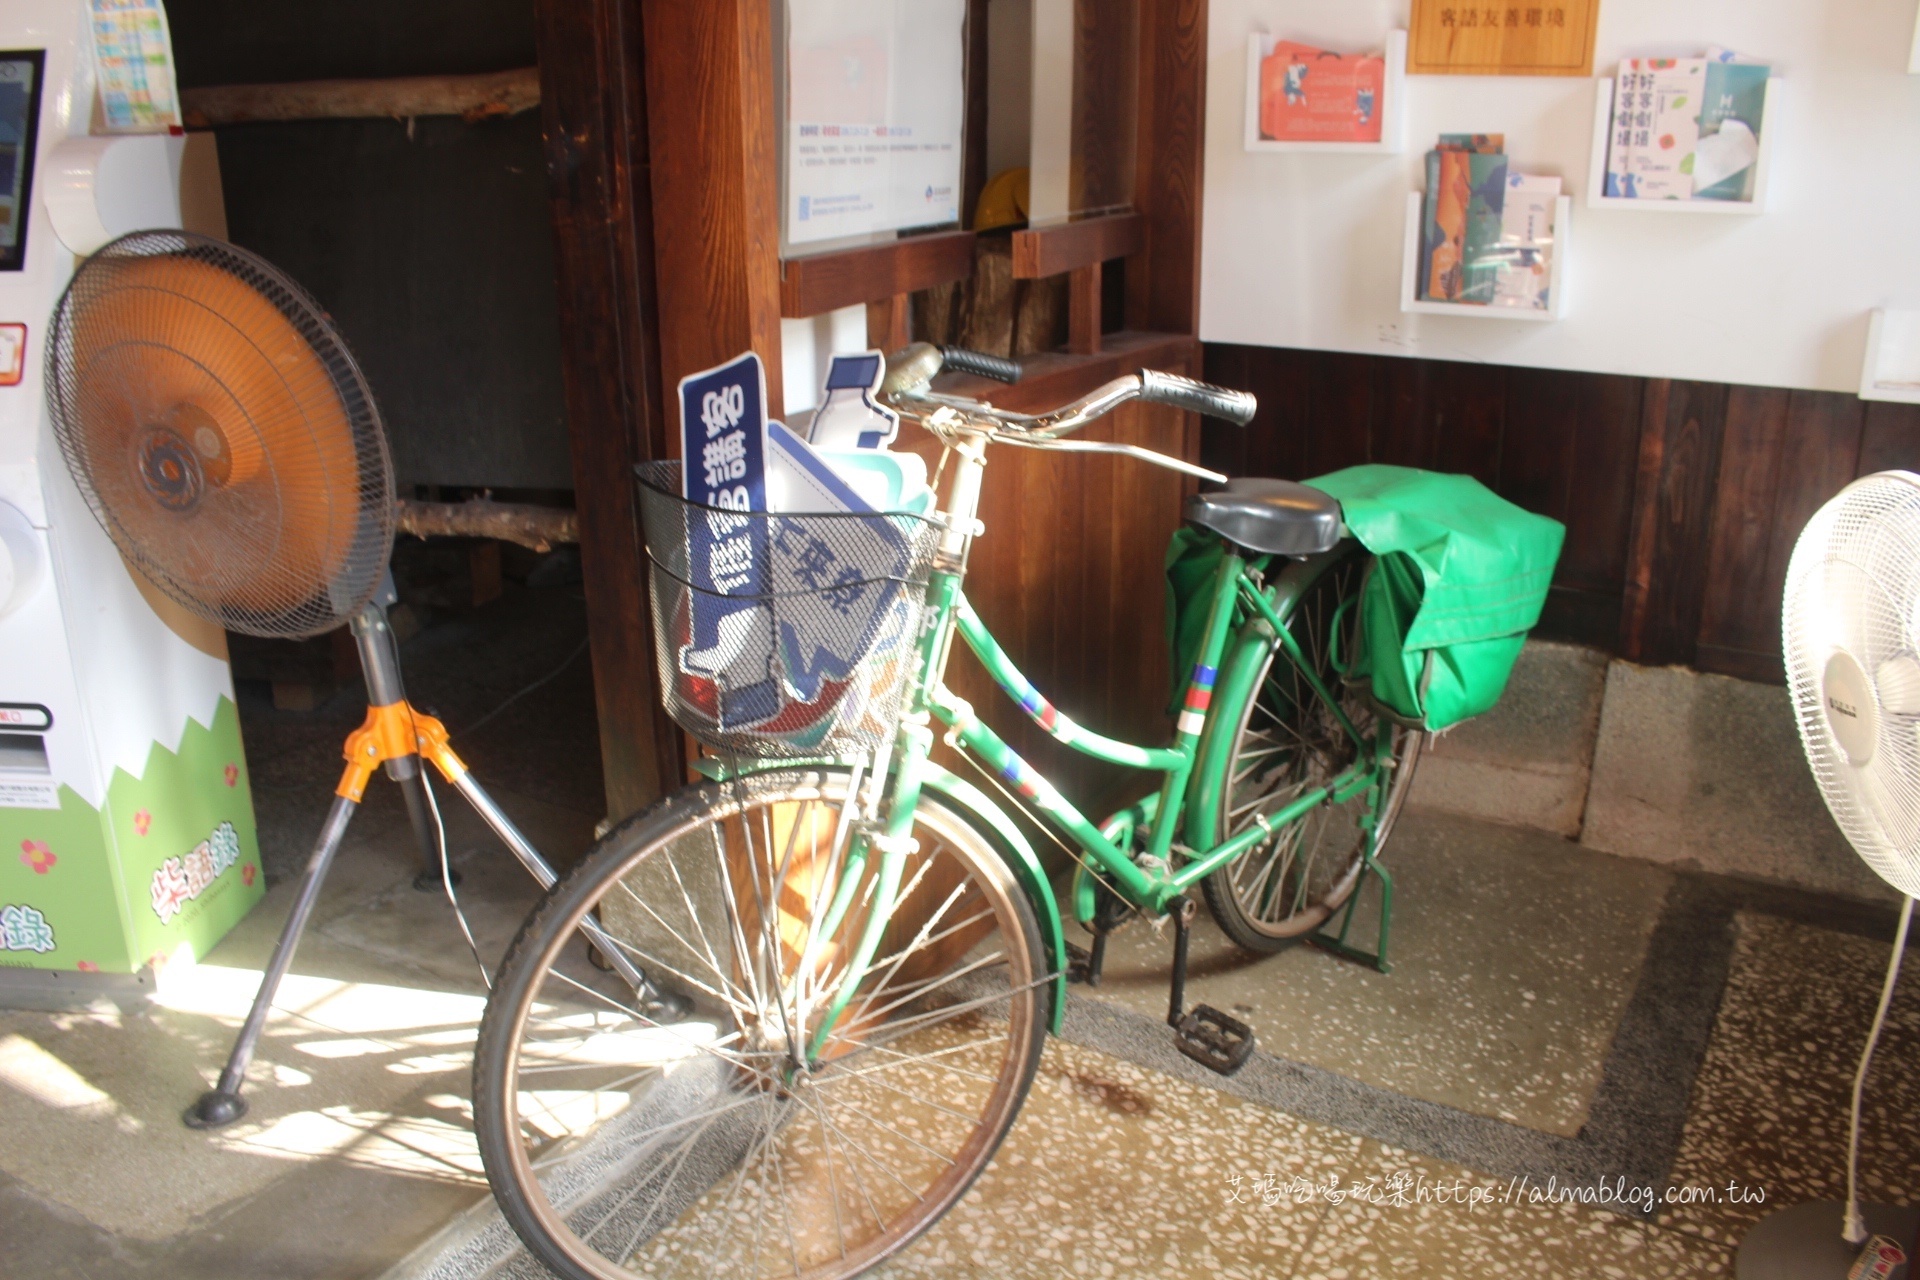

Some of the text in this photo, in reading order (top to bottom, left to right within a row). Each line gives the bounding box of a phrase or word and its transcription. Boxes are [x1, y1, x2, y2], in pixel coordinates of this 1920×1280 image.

[1440, 8, 1564, 28] 客語友善環境
[0, 904, 56, 953] 錄
